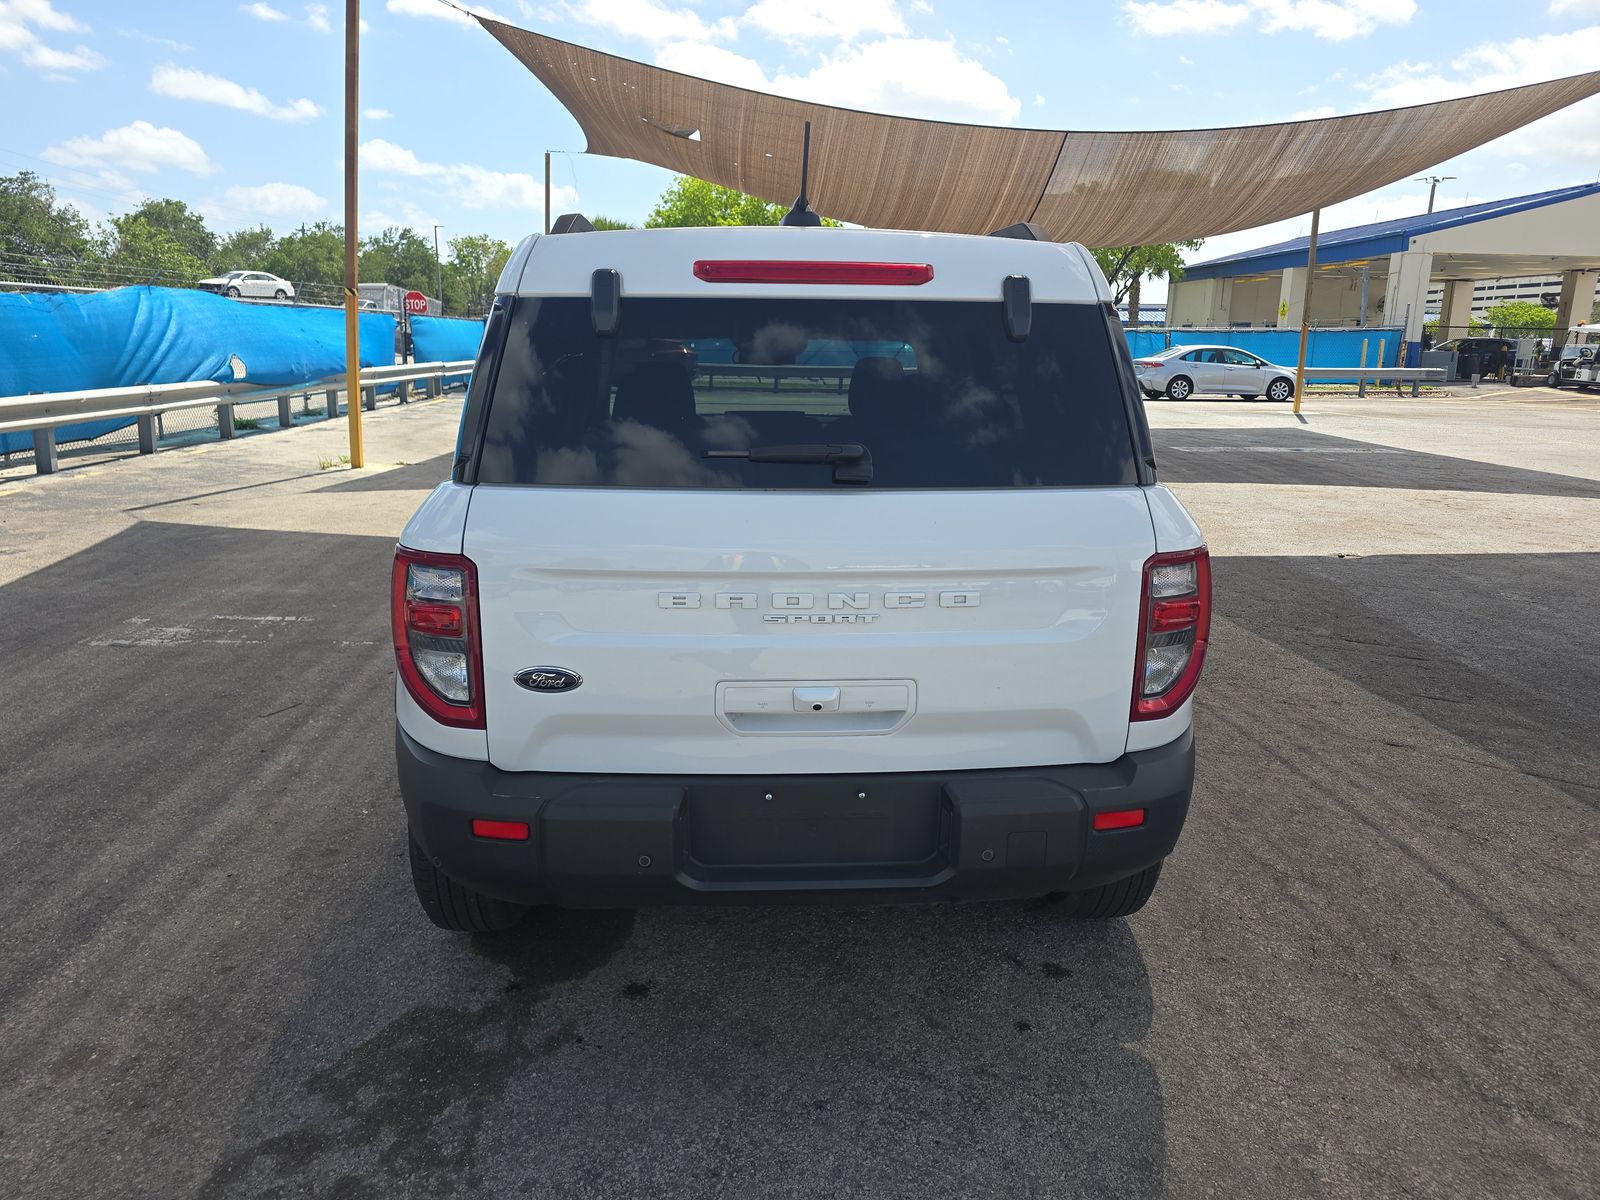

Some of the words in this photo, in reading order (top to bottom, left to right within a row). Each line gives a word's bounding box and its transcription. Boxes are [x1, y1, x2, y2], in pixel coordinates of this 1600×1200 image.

[405, 299, 426, 310] STOP
[658, 591, 981, 610] BRONCO
[762, 613, 880, 625] SPORT
[528, 671, 565, 688] Ford
